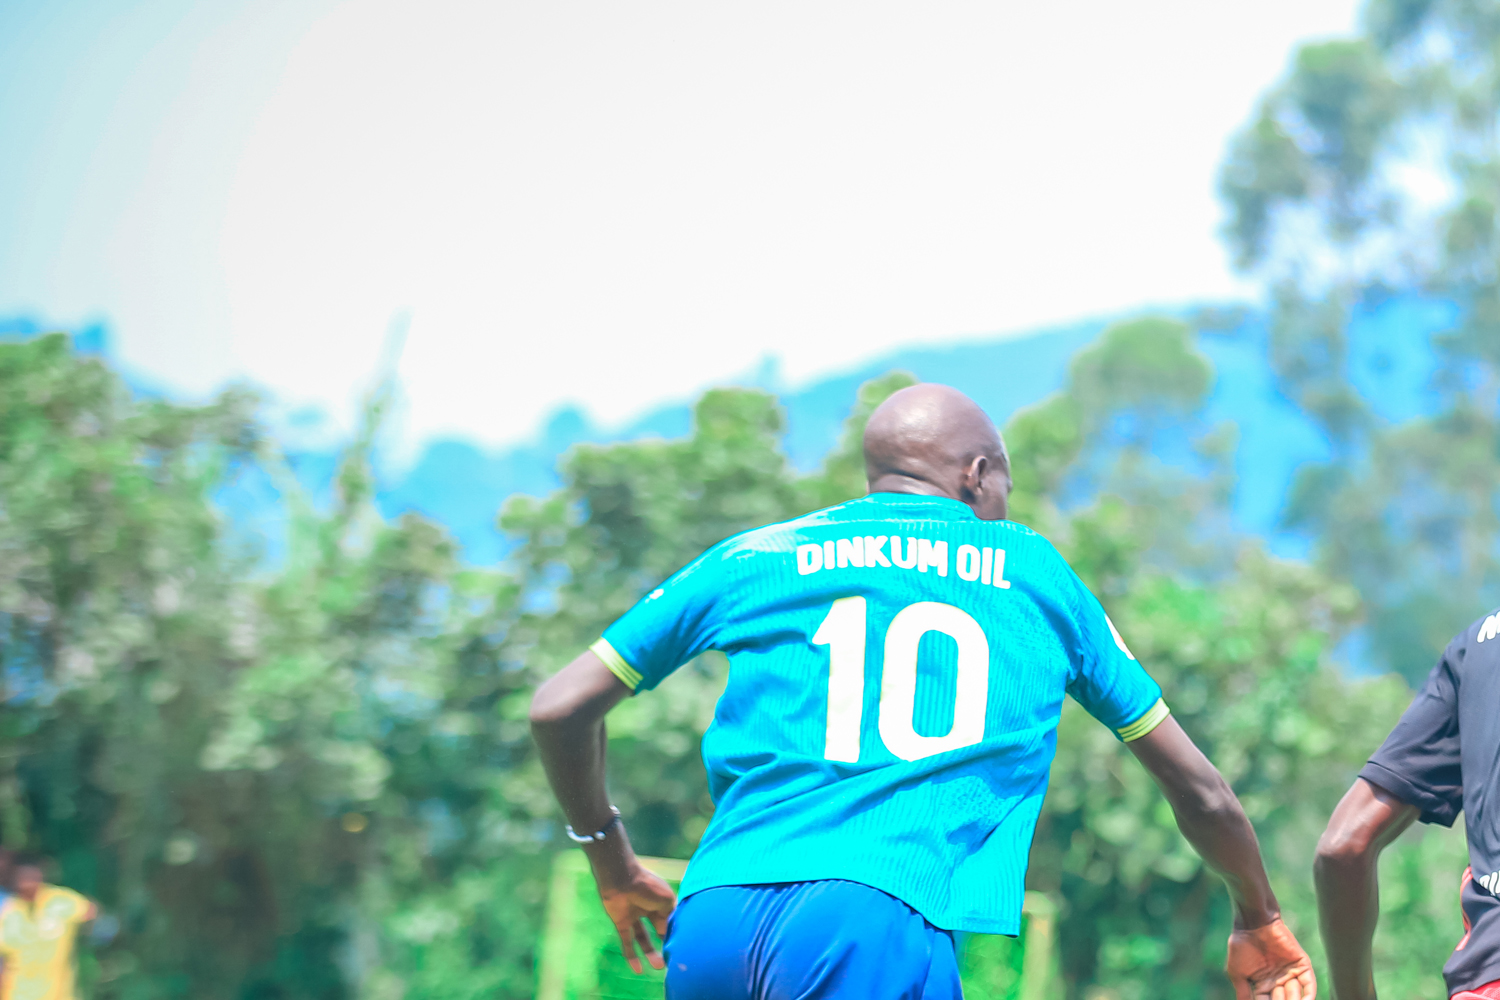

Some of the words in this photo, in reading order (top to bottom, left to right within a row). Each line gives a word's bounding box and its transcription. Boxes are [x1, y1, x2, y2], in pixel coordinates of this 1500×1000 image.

[796, 535, 949, 577] DINKUM
[956, 544, 1011, 589] OIL
[811, 595, 990, 763] 10
